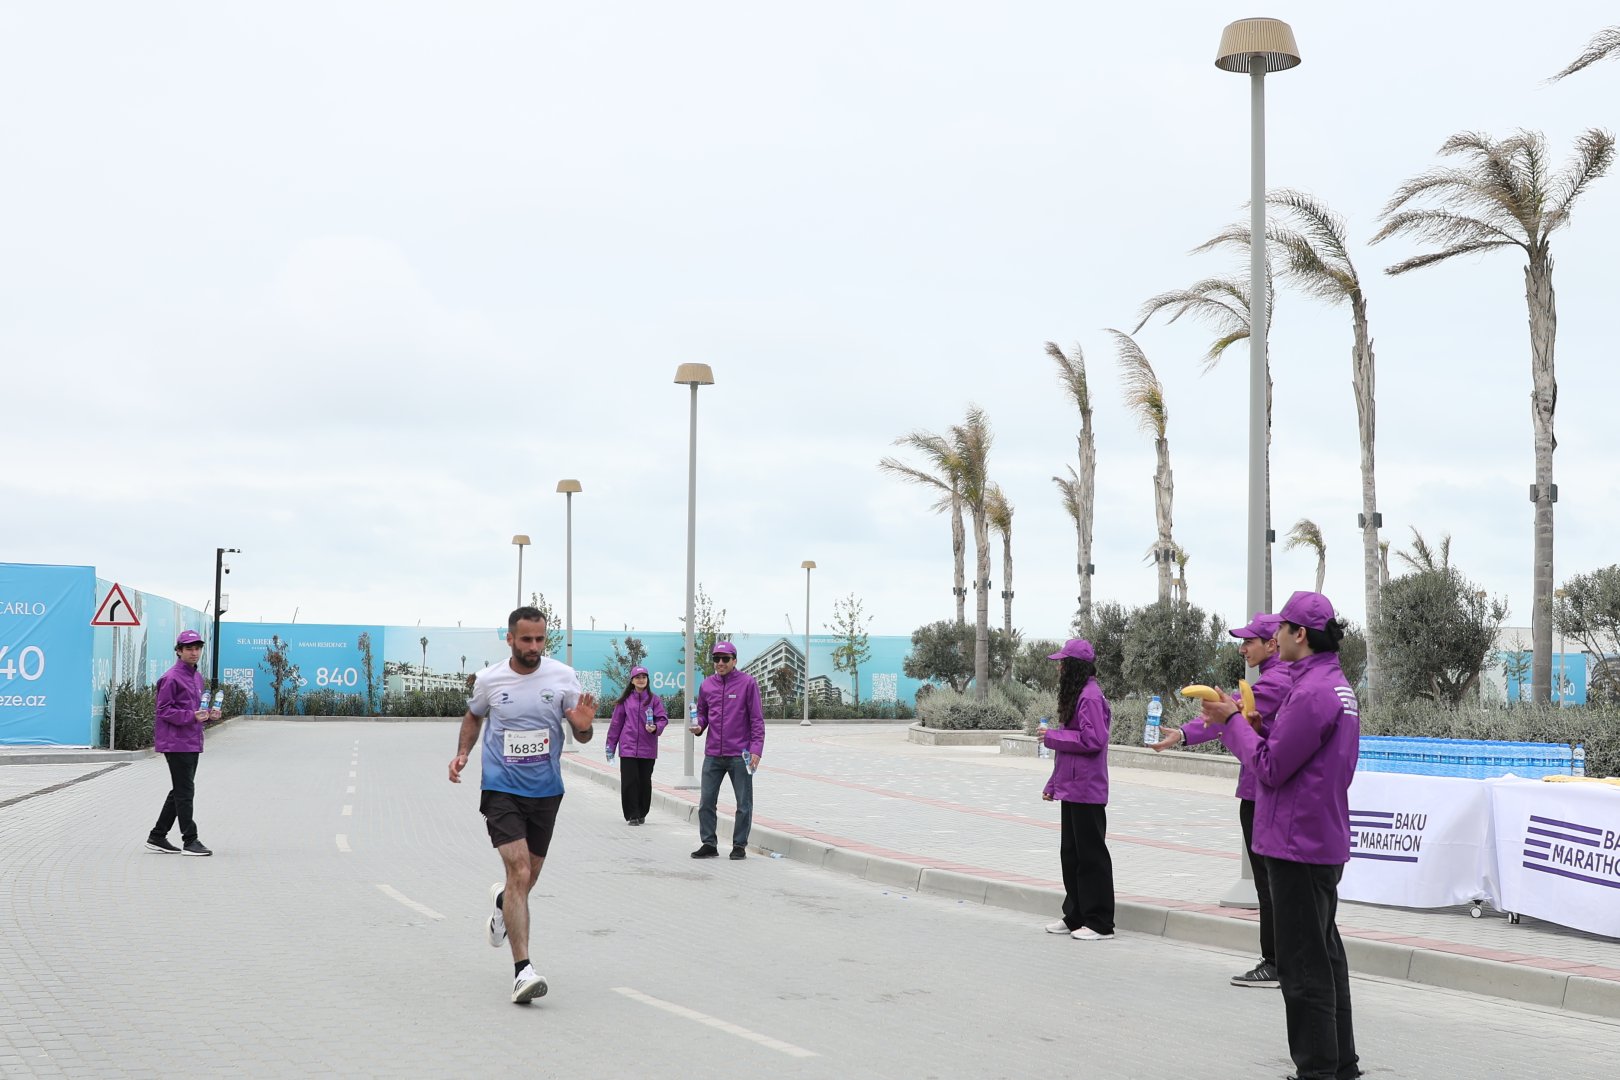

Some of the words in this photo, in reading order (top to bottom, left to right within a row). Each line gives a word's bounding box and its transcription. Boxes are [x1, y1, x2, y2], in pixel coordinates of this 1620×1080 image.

[316, 667, 357, 686] 840
[509, 742, 545, 754] 16833
[1395, 812, 1428, 831] BAKU
[1360, 831, 1422, 853] MARATHON
